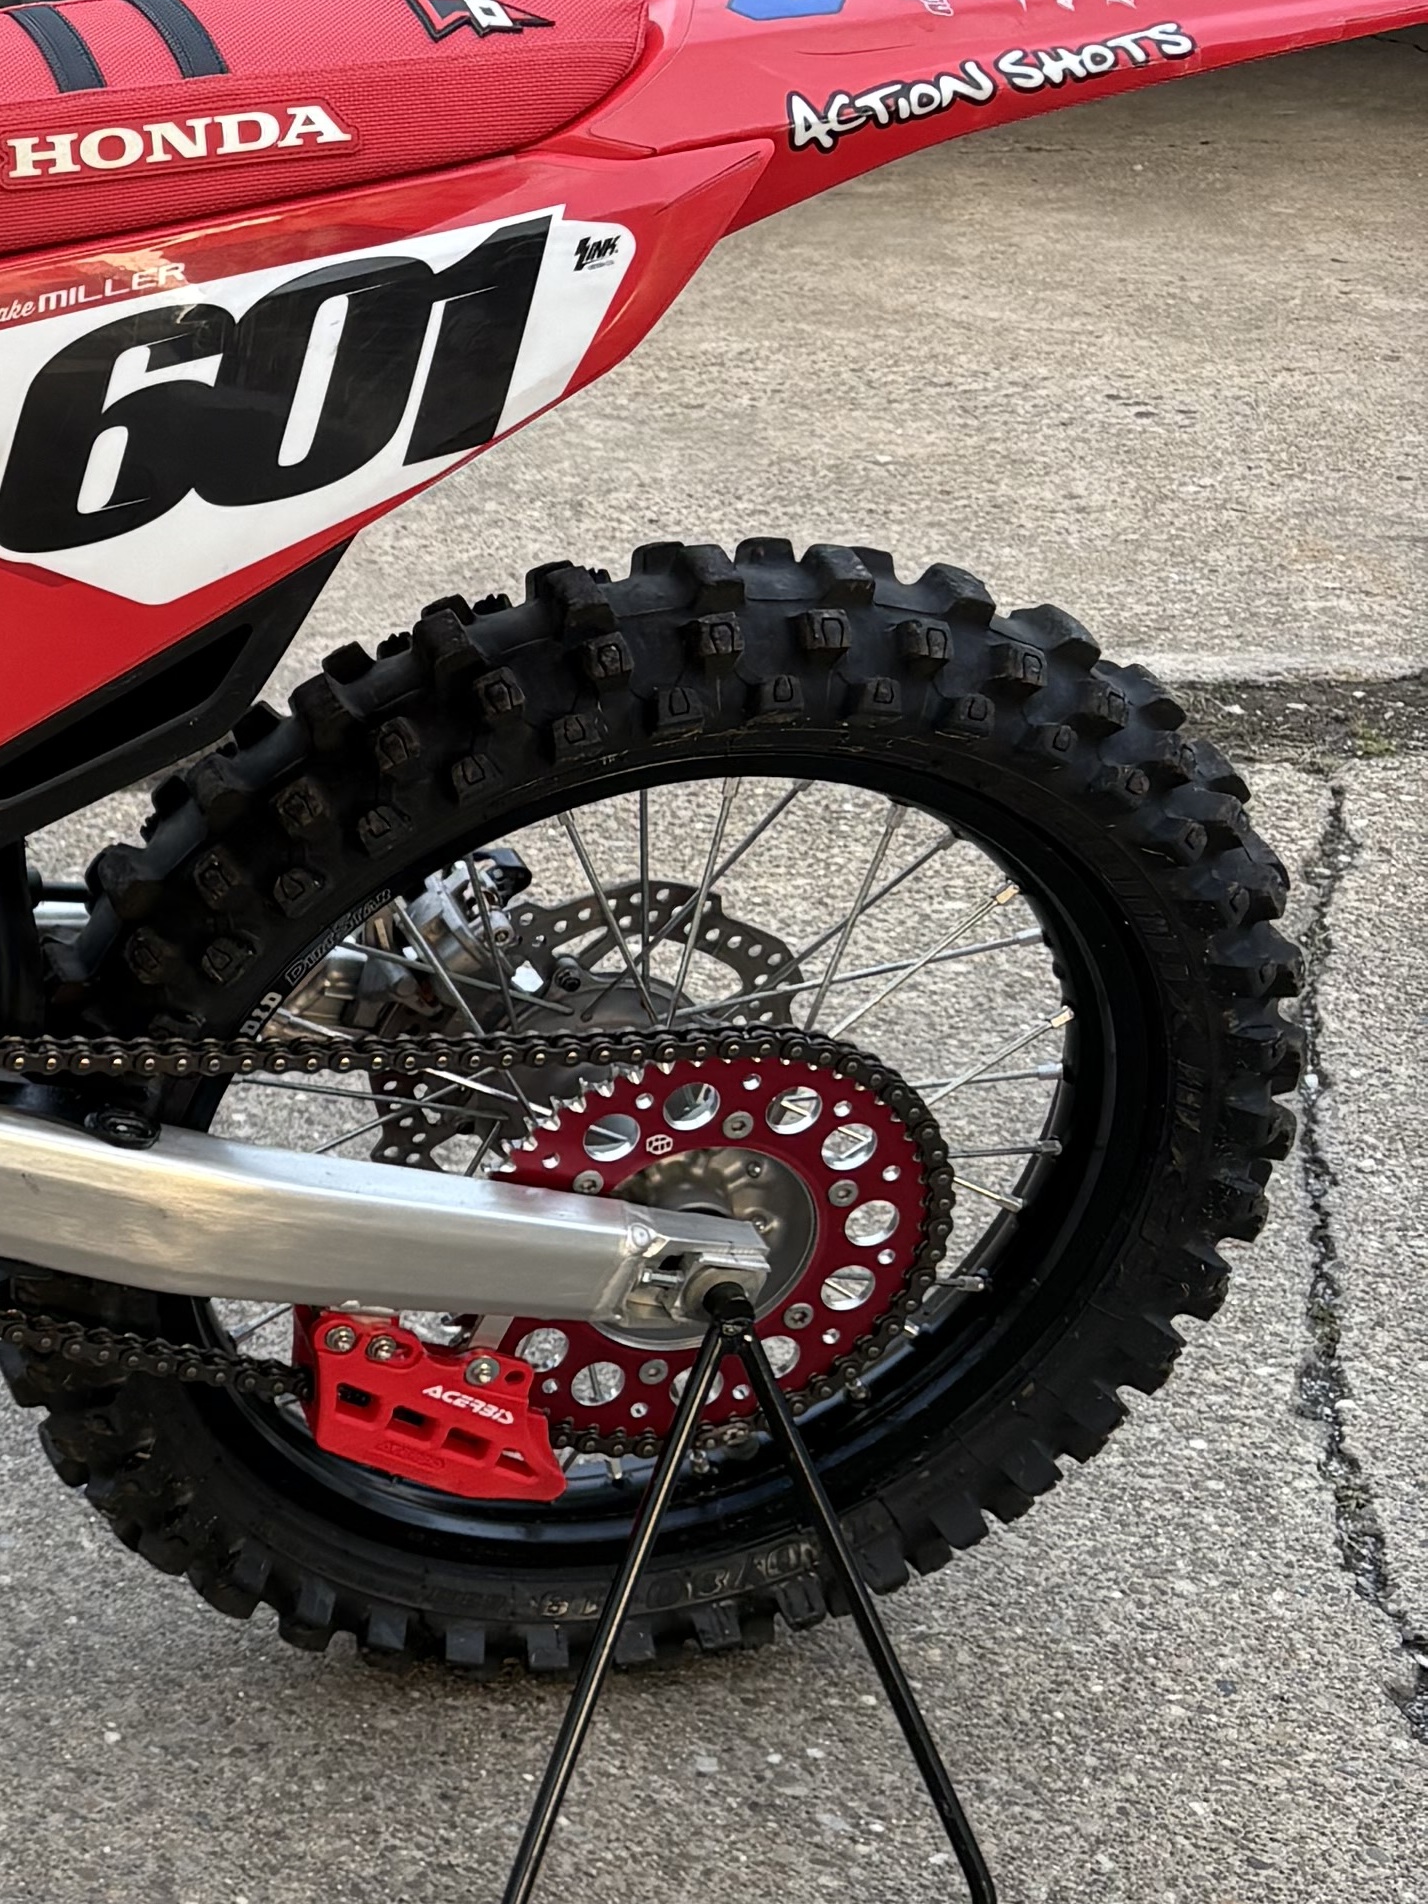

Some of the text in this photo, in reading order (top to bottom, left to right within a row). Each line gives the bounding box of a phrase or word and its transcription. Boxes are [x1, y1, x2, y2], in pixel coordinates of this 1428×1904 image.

[787, 21, 1197, 150] ACTION SHOTS
[8, 103, 352, 179] HONDA
[37, 262, 186, 313] MILLER
[239, 992, 283, 1037] DID
